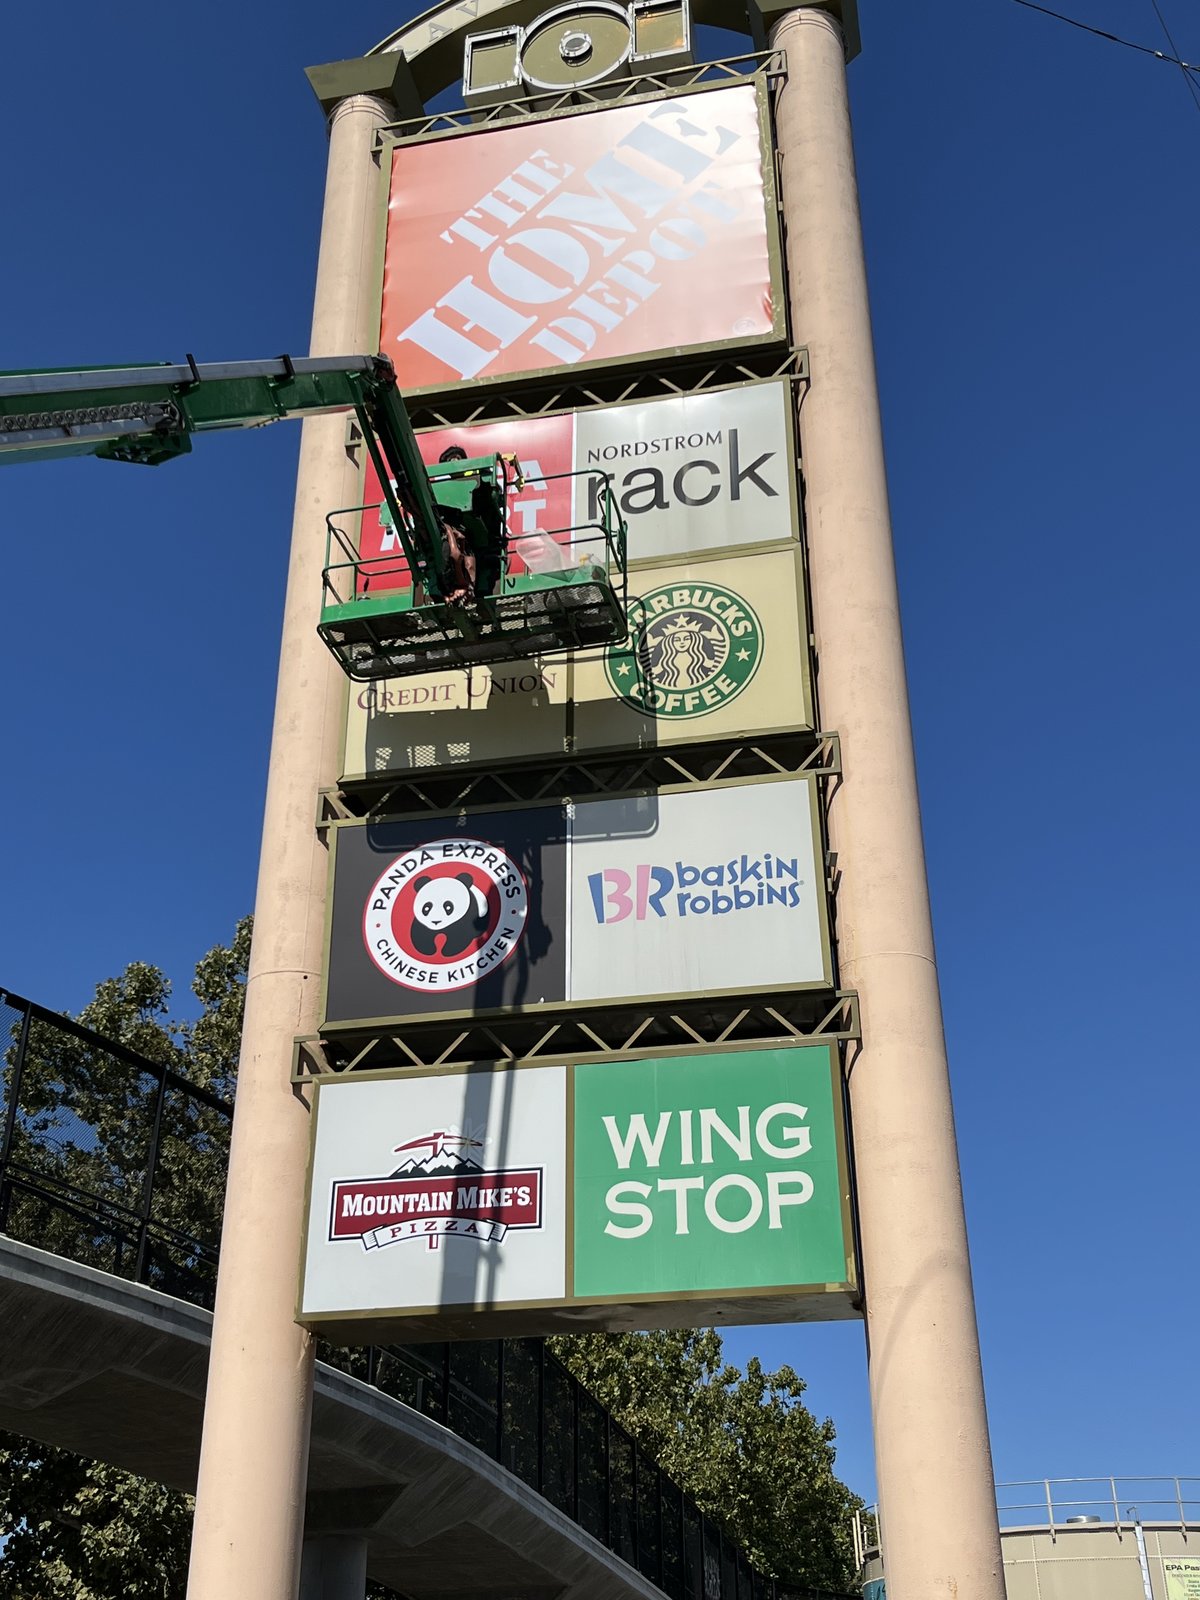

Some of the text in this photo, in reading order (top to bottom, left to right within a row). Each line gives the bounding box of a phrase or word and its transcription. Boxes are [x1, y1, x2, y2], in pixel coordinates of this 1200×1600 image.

[440, 149, 575, 253] THE
[397, 102, 741, 380] HOME
[528, 182, 743, 364] DEPOT
[587, 431, 723, 463] NORDSTROM
[587, 428, 780, 520] rack
[630, 674, 737, 712] COFFEE
[373, 843, 521, 911] PANDA EXPRESS
[676, 853, 798, 888] baskin
[376, 926, 514, 984] CHINESE KITCHEN
[601, 1102, 813, 1169] WING
[390, 1220, 479, 1238] PIZZA
[604, 1171, 814, 1238] STOP
